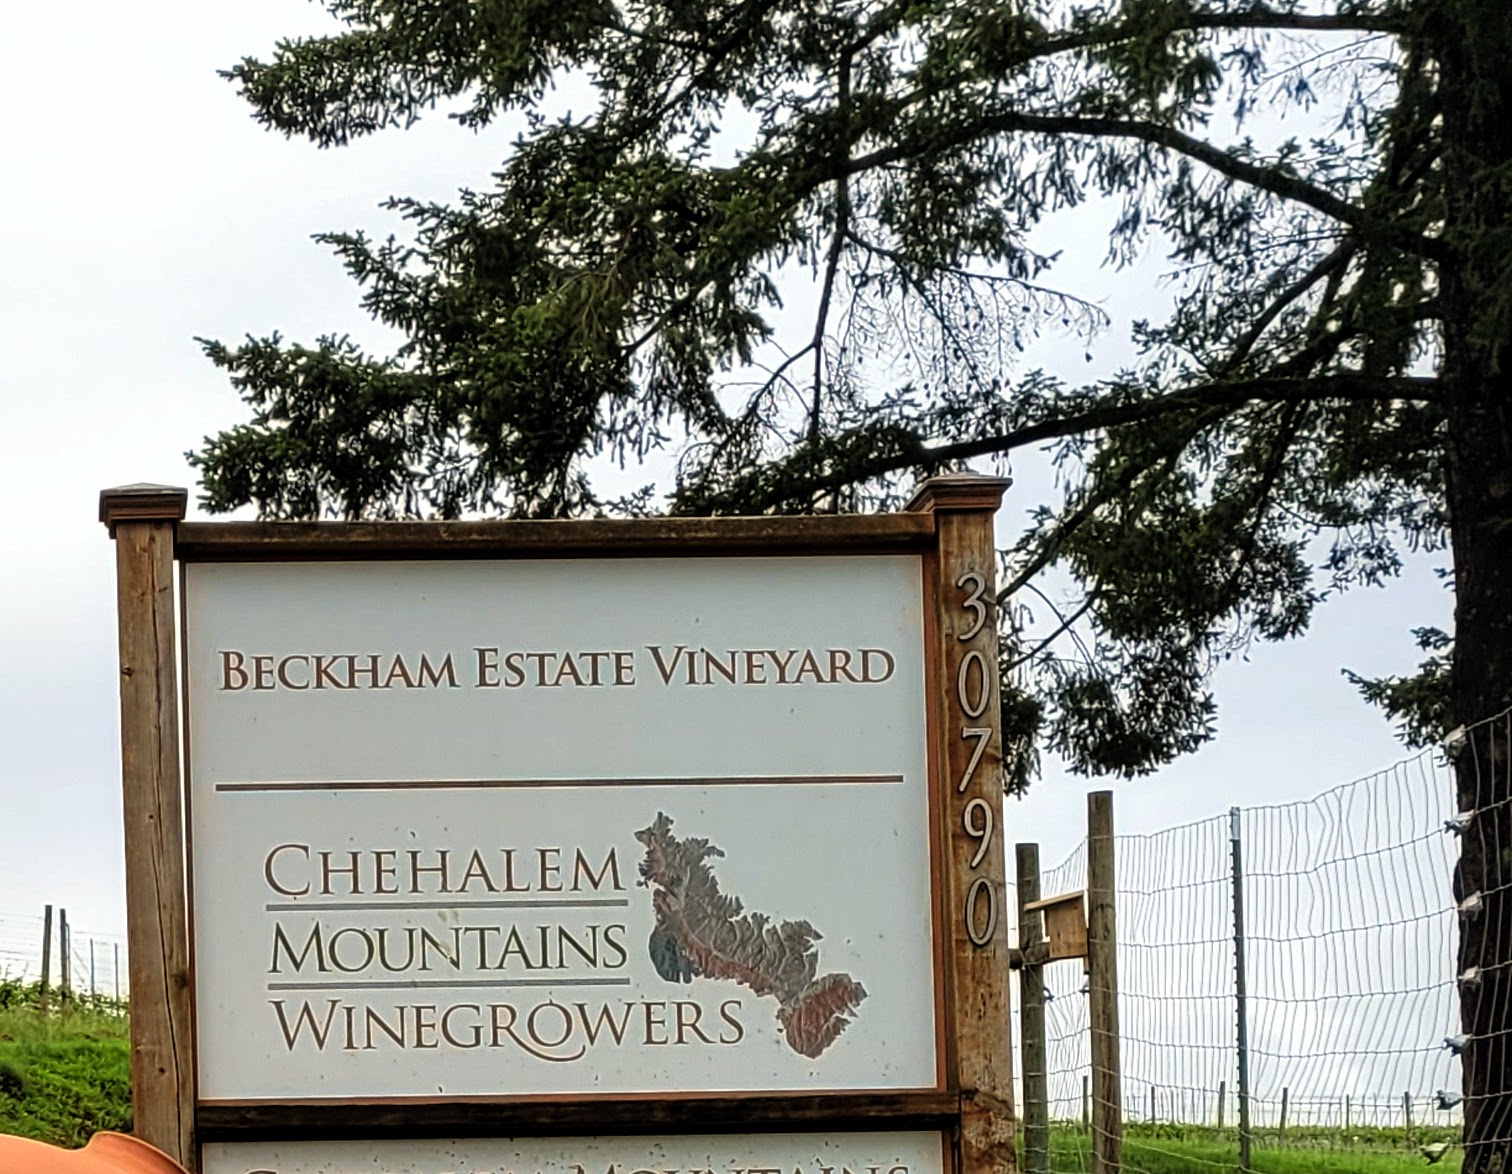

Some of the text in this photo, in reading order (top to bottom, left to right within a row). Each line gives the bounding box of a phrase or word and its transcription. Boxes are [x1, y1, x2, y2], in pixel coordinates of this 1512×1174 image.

[218, 644, 895, 692] BECKHAM ESTATE VINEYARD
[956, 571, 998, 947] 30790
[263, 843, 626, 897] CHEHALEM
[268, 923, 628, 974] MOUNTAINS
[270, 999, 744, 1062] WINEGROWERS
